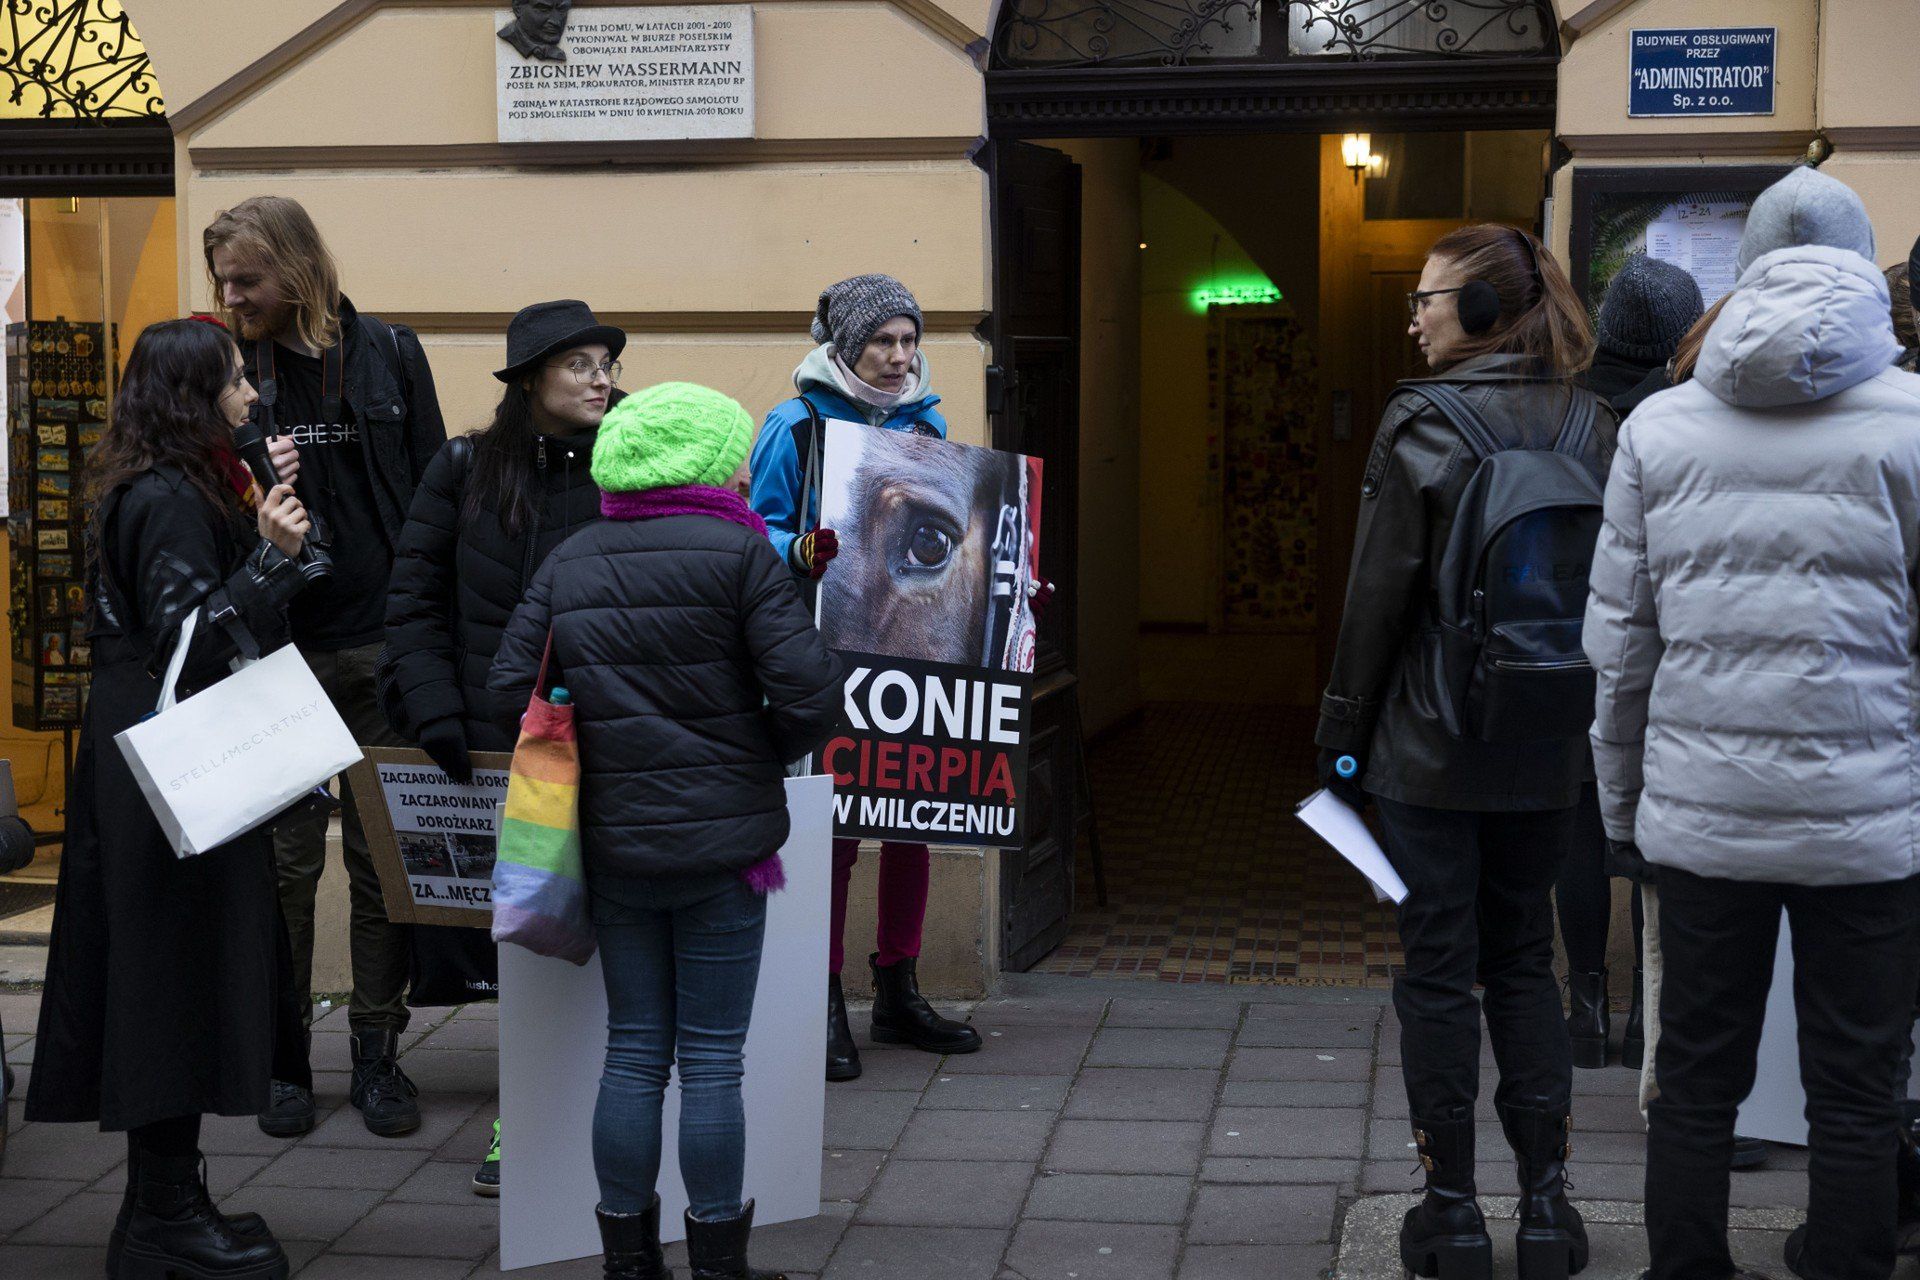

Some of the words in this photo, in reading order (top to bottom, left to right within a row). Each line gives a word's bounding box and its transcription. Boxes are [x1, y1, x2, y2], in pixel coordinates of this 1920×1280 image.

[568, 25, 577, 33] W
[578, 24, 598, 32] TYM
[601, 23, 634, 32] DOMU,
[635, 23, 644, 31] W
[686, 22, 707, 30] 2001
[713, 21, 732, 29] 2010
[566, 35, 628, 44] WYKONYWAŁ
[631, 34, 641, 42] W
[642, 33, 676, 41] BIURZE
[679, 32, 732, 41] POSELSKIM
[1637, 36, 1687, 46] BUDYNEK
[1693, 34, 1771, 45] OBSŁUGIWANY
[572, 46, 627, 56] OBOWIĄZKI
[631, 44, 730, 54] PARLAMENTARZYSTY
[1686, 48, 1720, 58] PRZEZ
[510, 63, 603, 79] ZBIGNIEW
[608, 61, 742, 77] WASSERMANN
[506, 81, 535, 89] POSEŁ
[537, 81, 550, 89] NA
[553, 81, 579, 90] SEJM,
[581, 79, 647, 88] PROKURATOR,
[649, 78, 695, 87] MINISTER
[697, 78, 731, 87] RZĄDU
[513, 100, 547, 109] ZGINĄŁ
[560, 98, 621, 107] KATASTROFIE
[623, 97, 684, 106] RZĄDOWEGO
[686, 96, 739, 105] SAMOLOTU
[1673, 94, 1694, 109] Sp.
[1698, 96, 1705, 106] z
[1709, 96, 1733, 106] o.o.
[509, 111, 528, 119] POD
[531, 109, 596, 119] SMOLEŃSKIEM
[599, 109, 608, 117] W
[610, 109, 634, 117] DNIU
[647, 108, 694, 116] KWIETNIA
[697, 107, 716, 115] 2010
[718, 107, 744, 115] ROKU
[843, 667, 1022, 745] KONIE
[822, 736, 1017, 806] CIERPIĄ
[400, 794, 497, 809] ZACZAROWANY
[832, 794, 853, 825] W
[859, 796, 1015, 836] MILCZENIU
[416, 814, 494, 831] DOROŻKARZ
